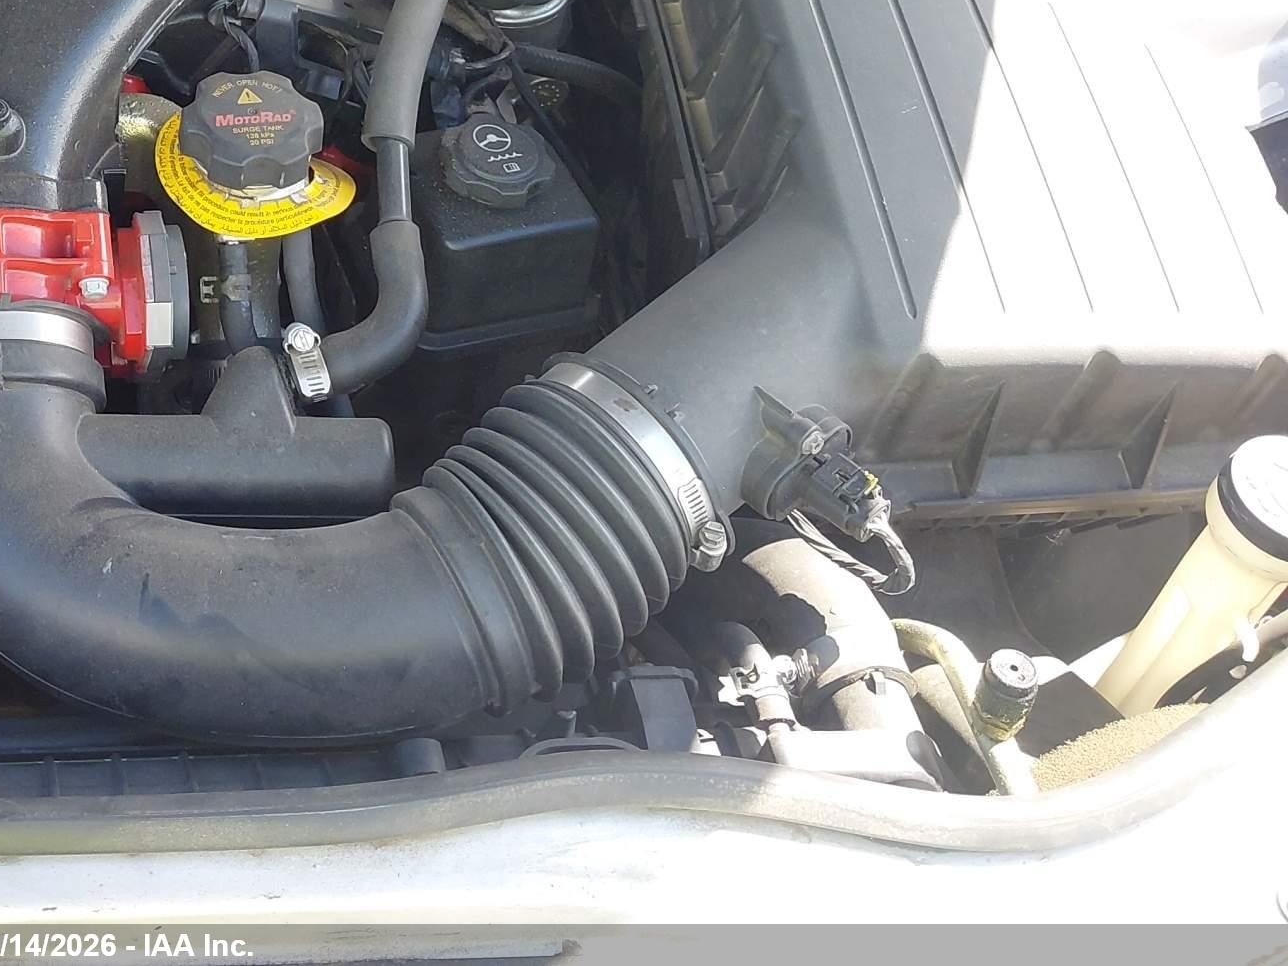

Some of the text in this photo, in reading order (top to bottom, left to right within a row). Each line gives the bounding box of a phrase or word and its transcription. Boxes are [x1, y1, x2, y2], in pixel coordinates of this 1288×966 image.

[236, 79, 258, 87] OPEN
[232, 124, 285, 134] SURGE TANK
